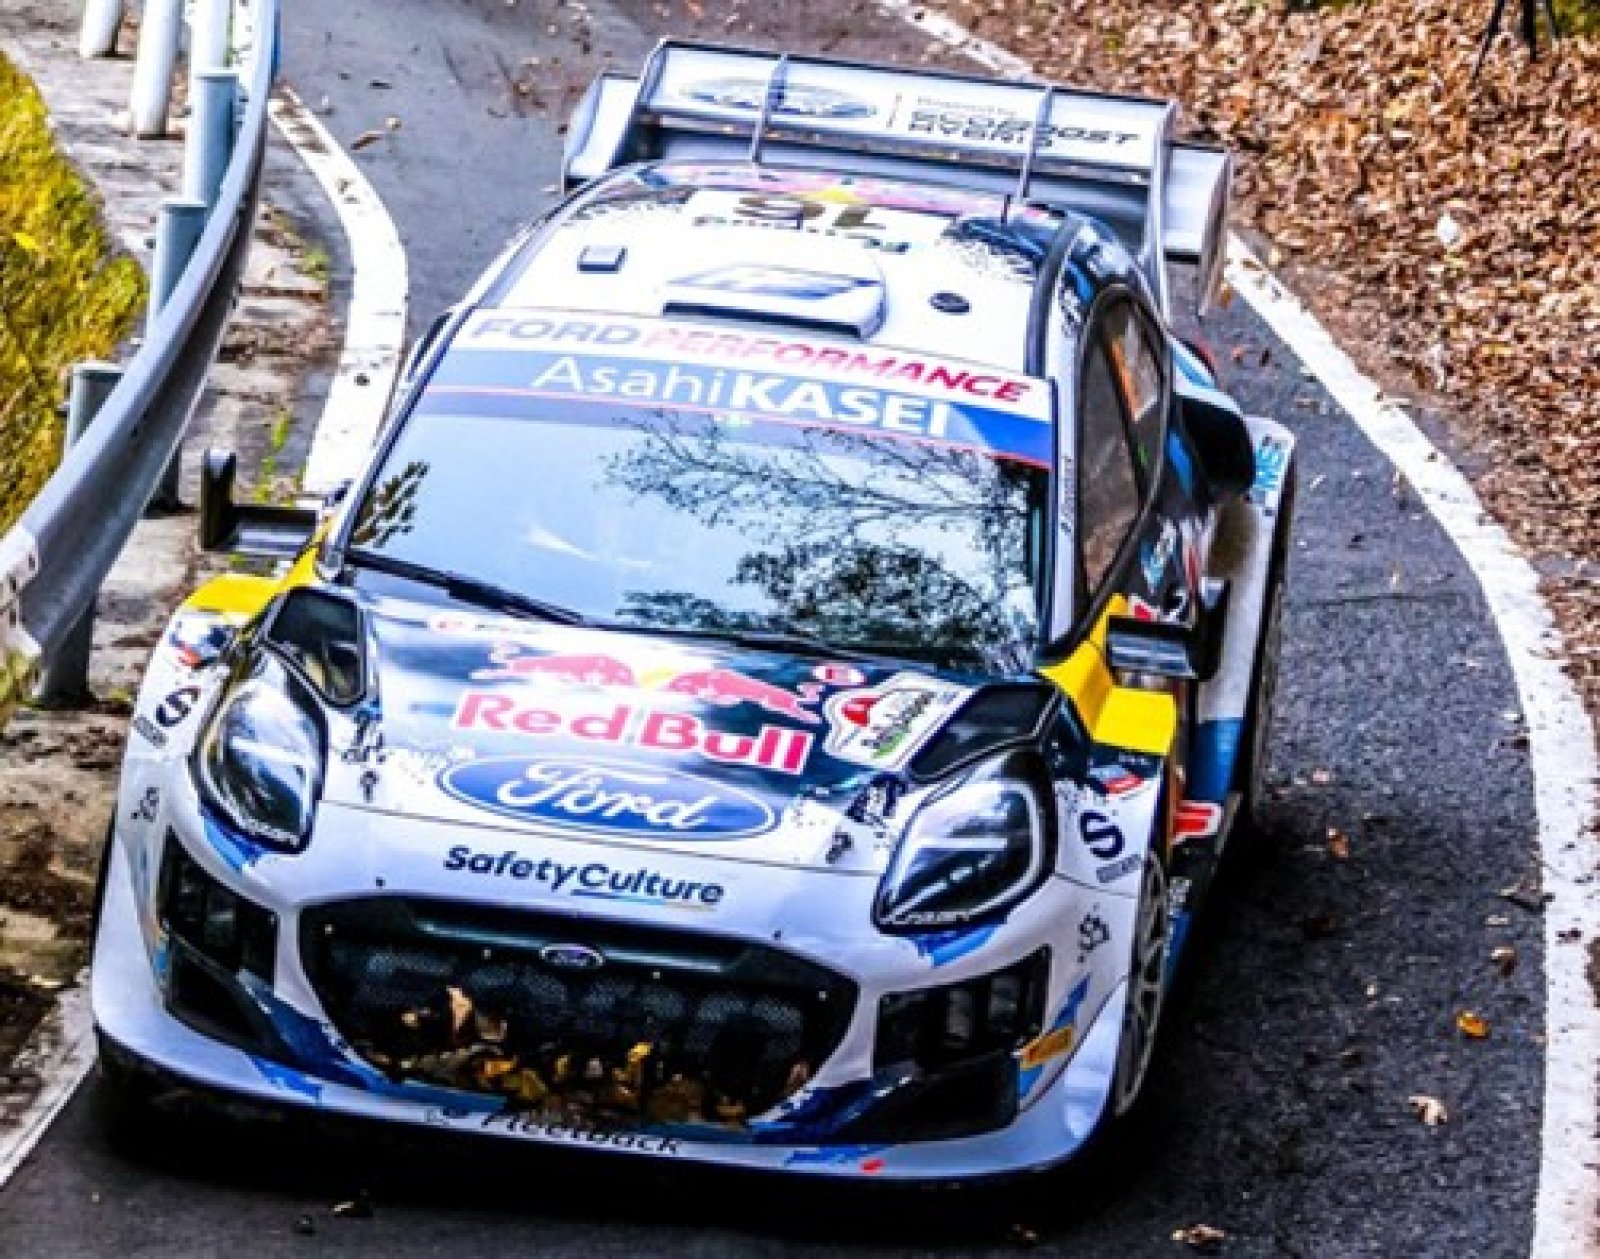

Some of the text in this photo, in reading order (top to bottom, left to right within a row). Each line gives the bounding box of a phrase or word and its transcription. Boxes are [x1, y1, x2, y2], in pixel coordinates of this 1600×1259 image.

[471, 317, 1031, 402] FORD PERFORMANCE
[457, 693, 632, 741] Red
[640, 711, 809, 771] Bull
[497, 761, 719, 829] Ford
[443, 843, 726, 903] SafetyCulture
